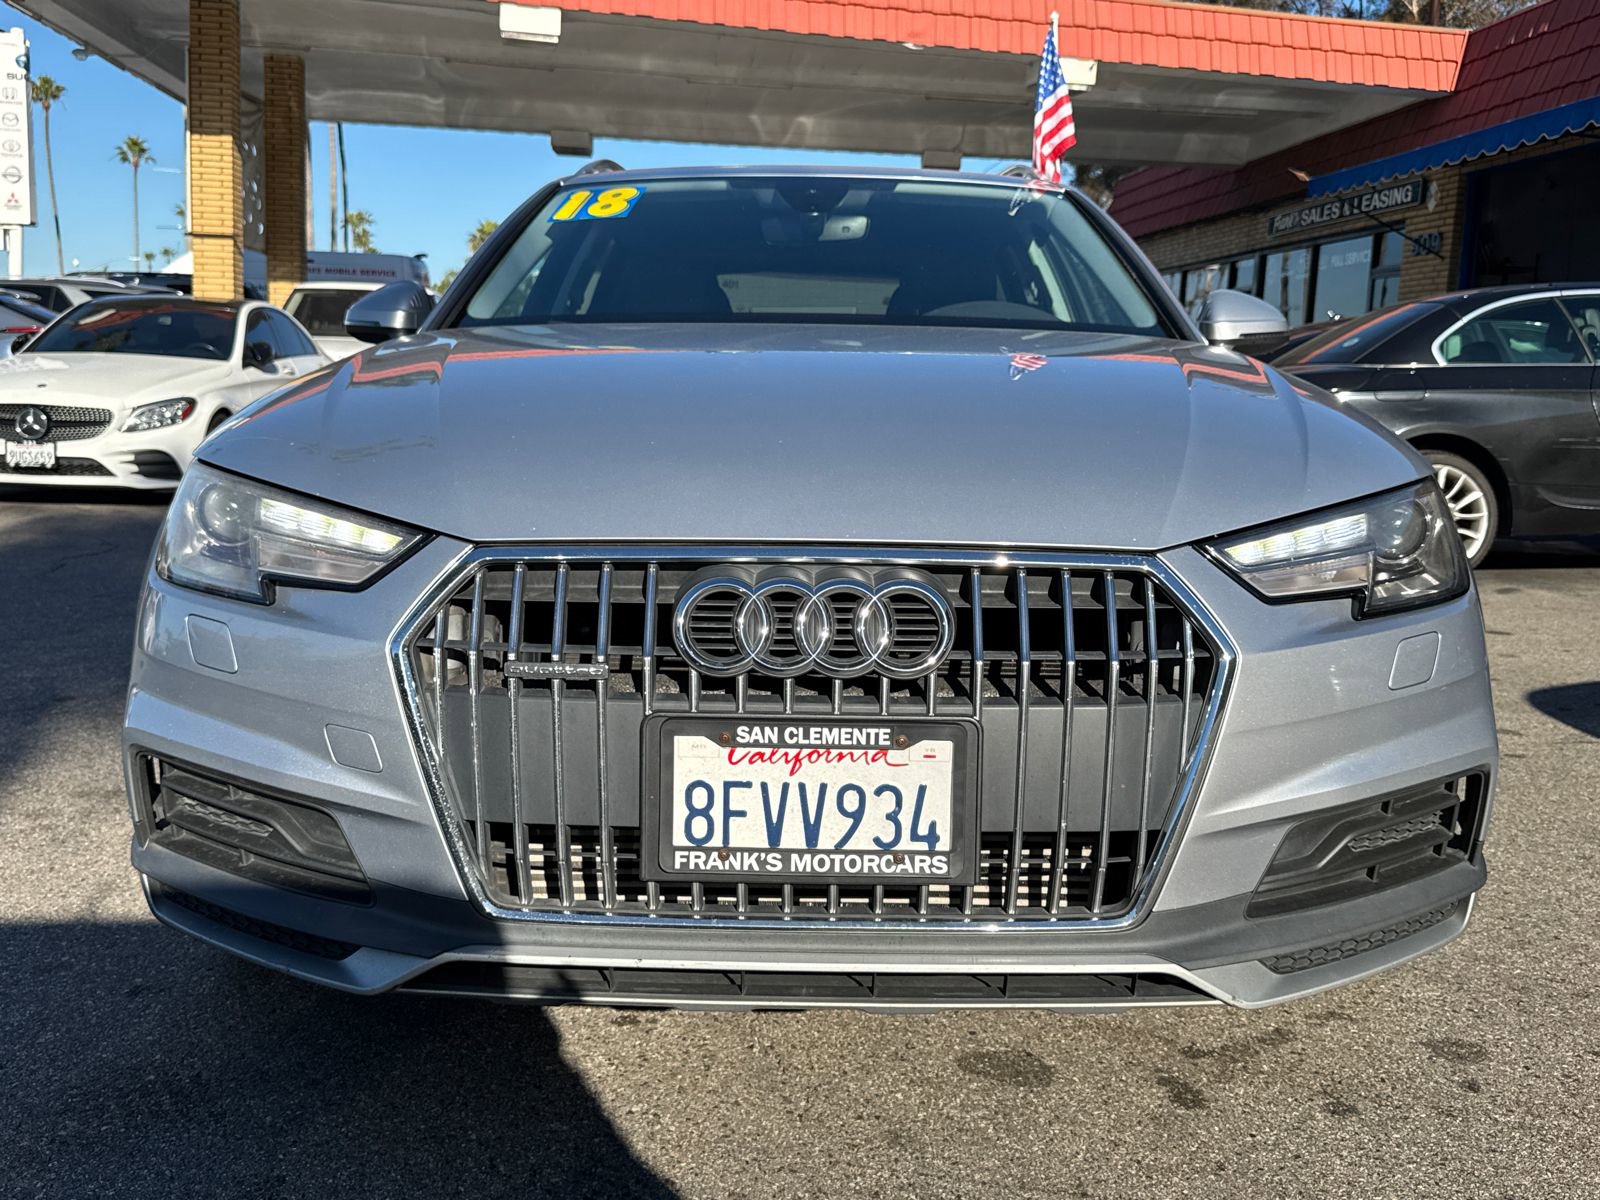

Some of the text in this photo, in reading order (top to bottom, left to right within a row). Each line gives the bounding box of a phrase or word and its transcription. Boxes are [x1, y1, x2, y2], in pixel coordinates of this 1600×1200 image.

[553, 187, 639, 220] 18
[1301, 202, 1340, 225] SALES
[1343, 203, 1350, 216] &
[1352, 185, 1412, 214] LEASING
[325, 267, 356, 276] MOBILE
[360, 267, 396, 277] SERVICE
[735, 726, 891, 746] SAN CLEMENTE
[727, 747, 910, 776] California
[684, 779, 940, 850] 8FVV934
[674, 851, 948, 874] FRANK'S MOTORCARS
